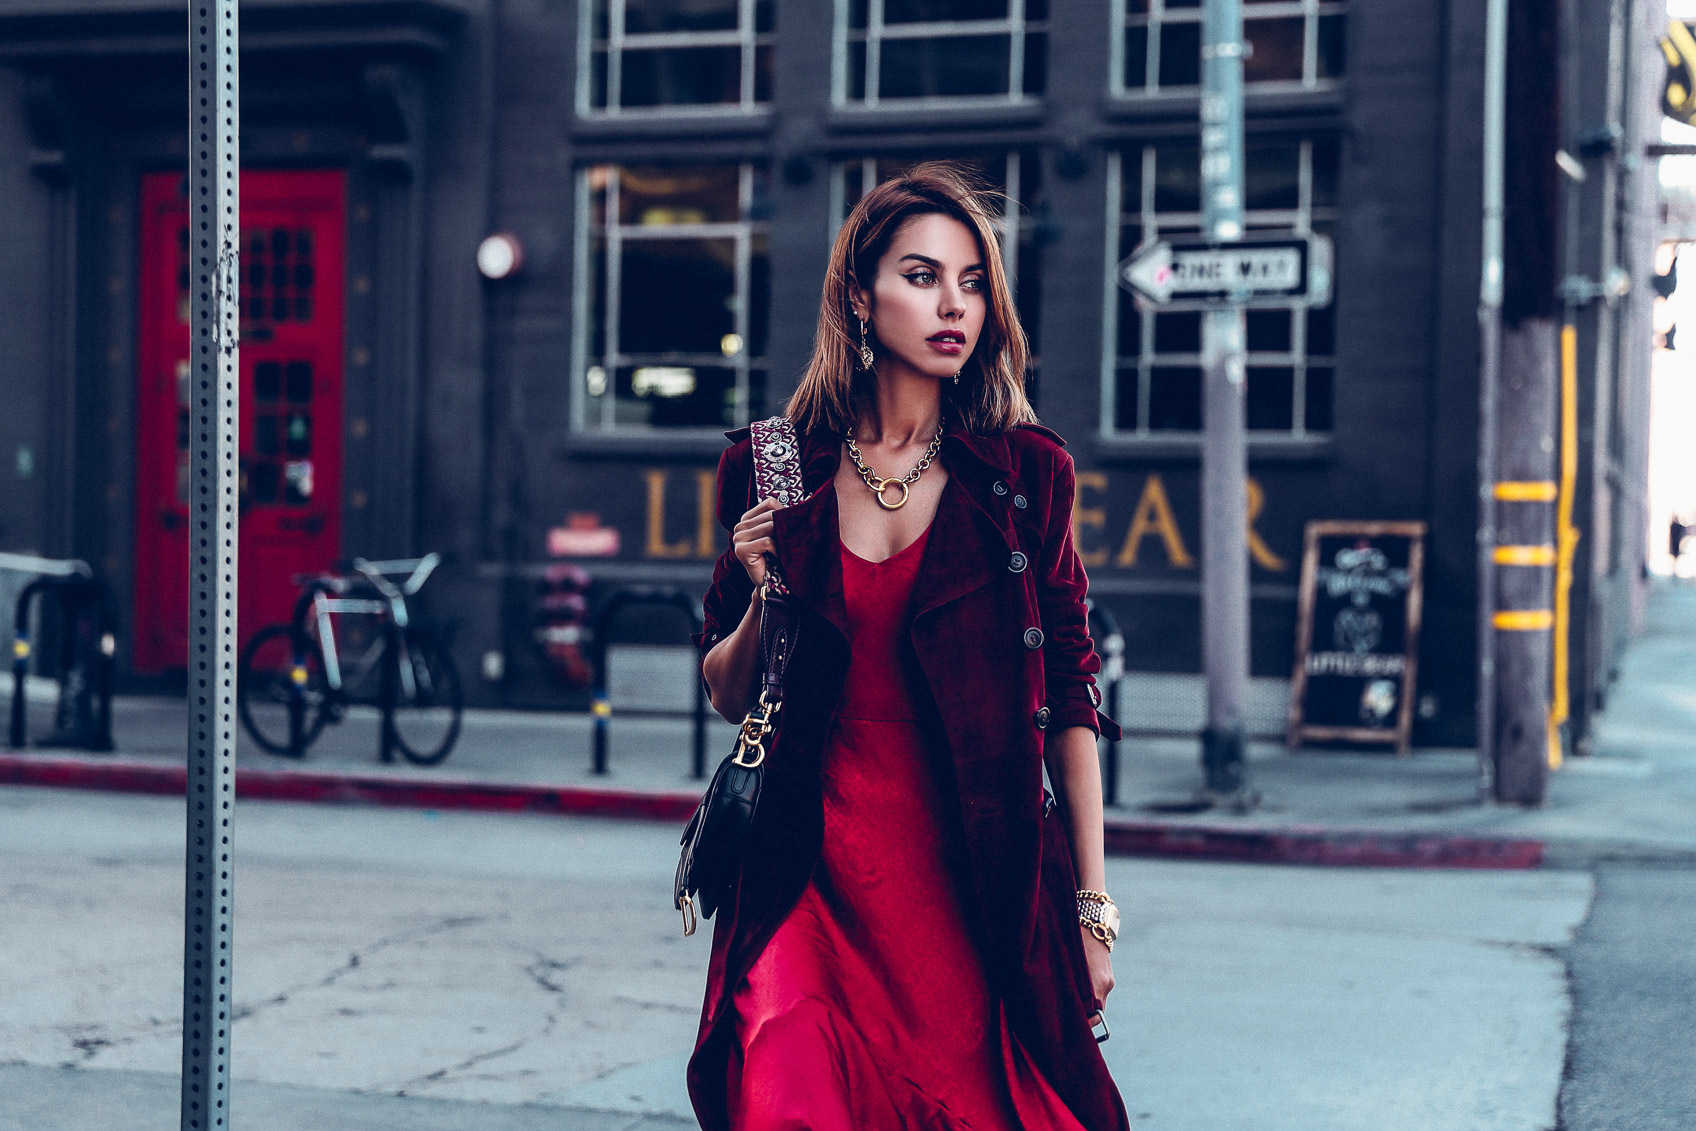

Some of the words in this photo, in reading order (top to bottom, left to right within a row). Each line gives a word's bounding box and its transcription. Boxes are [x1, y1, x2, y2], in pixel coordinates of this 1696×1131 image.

[1174, 257, 1224, 284] ONE
[1238, 255, 1292, 283] WAY
[646, 471, 715, 557] LI
[1074, 472, 1284, 570] EAR
